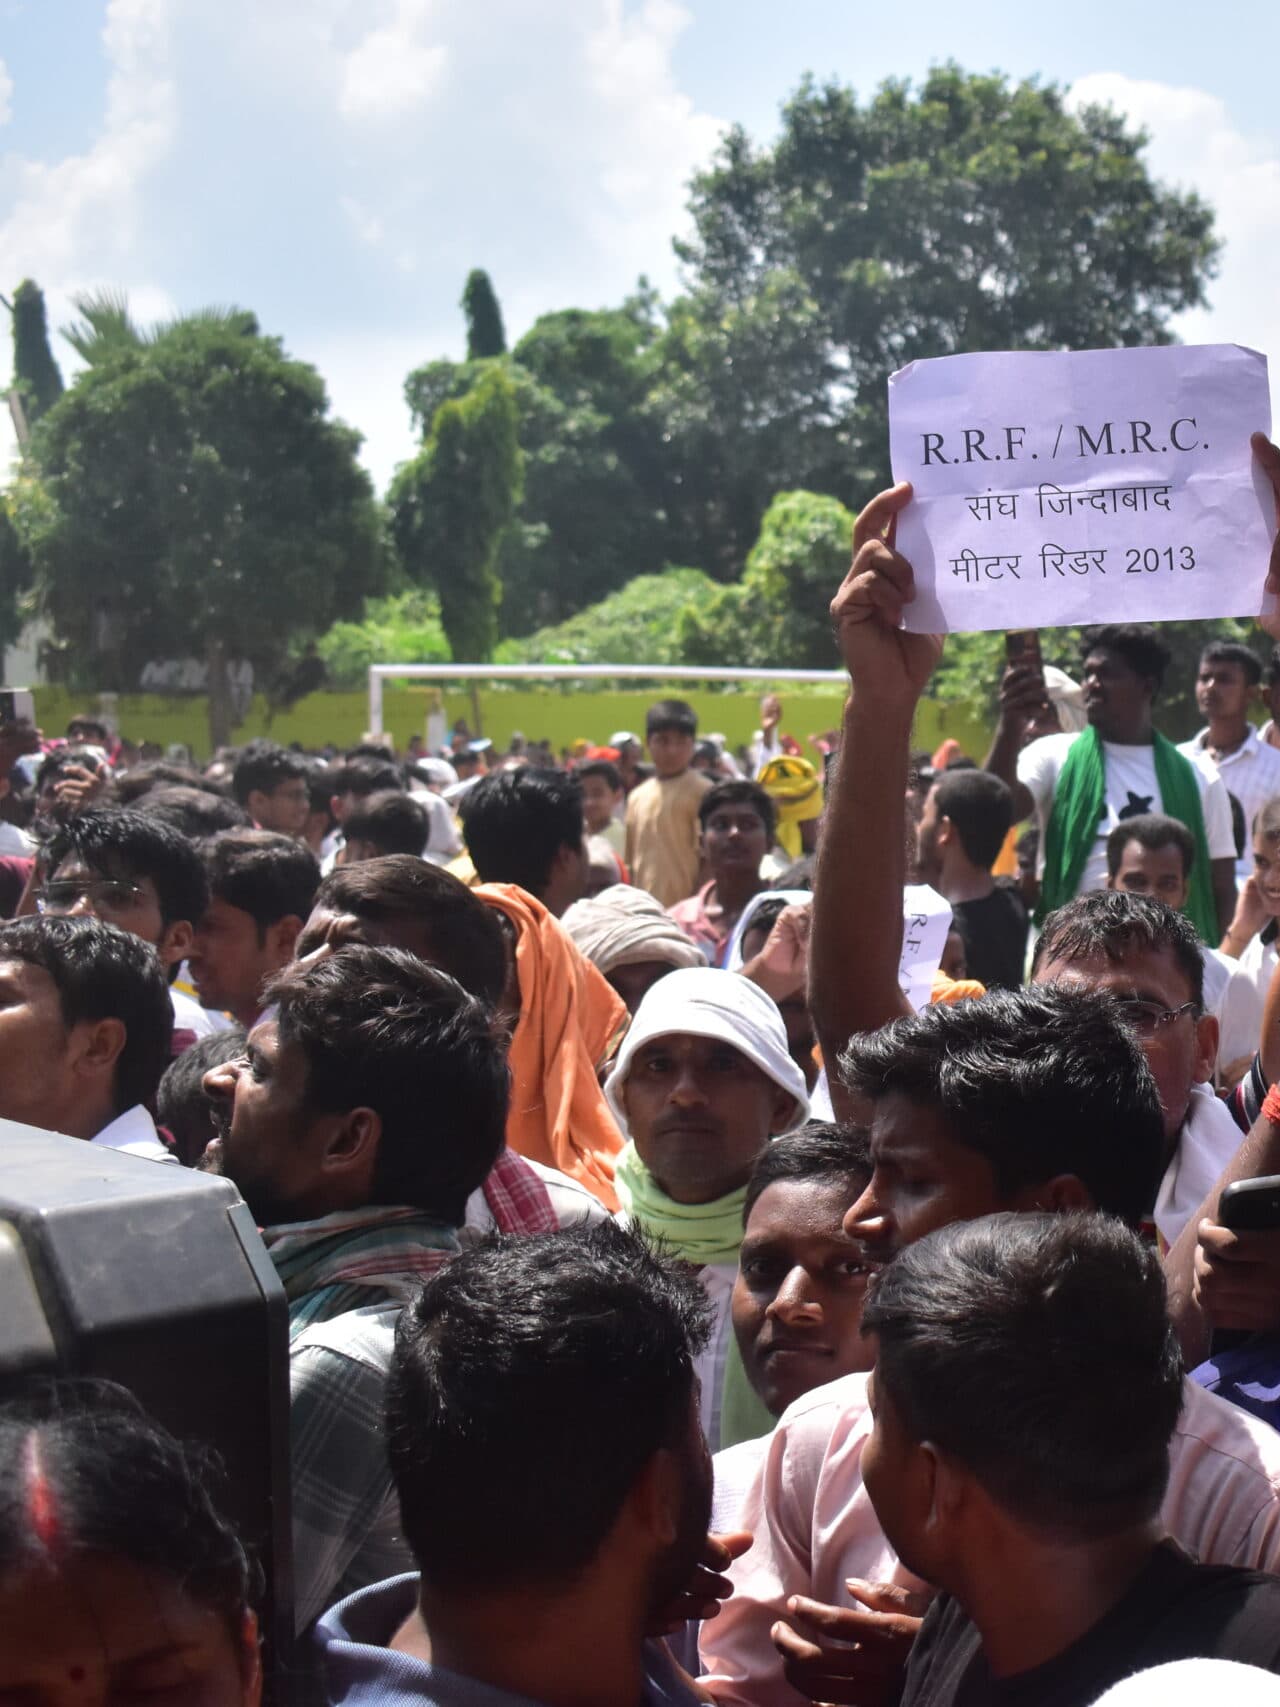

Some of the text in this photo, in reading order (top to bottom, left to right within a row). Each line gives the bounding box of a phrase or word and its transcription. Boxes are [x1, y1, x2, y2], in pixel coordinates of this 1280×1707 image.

[920, 427, 1038, 465] R.R.F.
[1075, 418, 1209, 457] M.R.C.
[965, 483, 1172, 521] संघ जिन्दाबाद
[949, 543, 1196, 583] मीटर रिडर 2013
